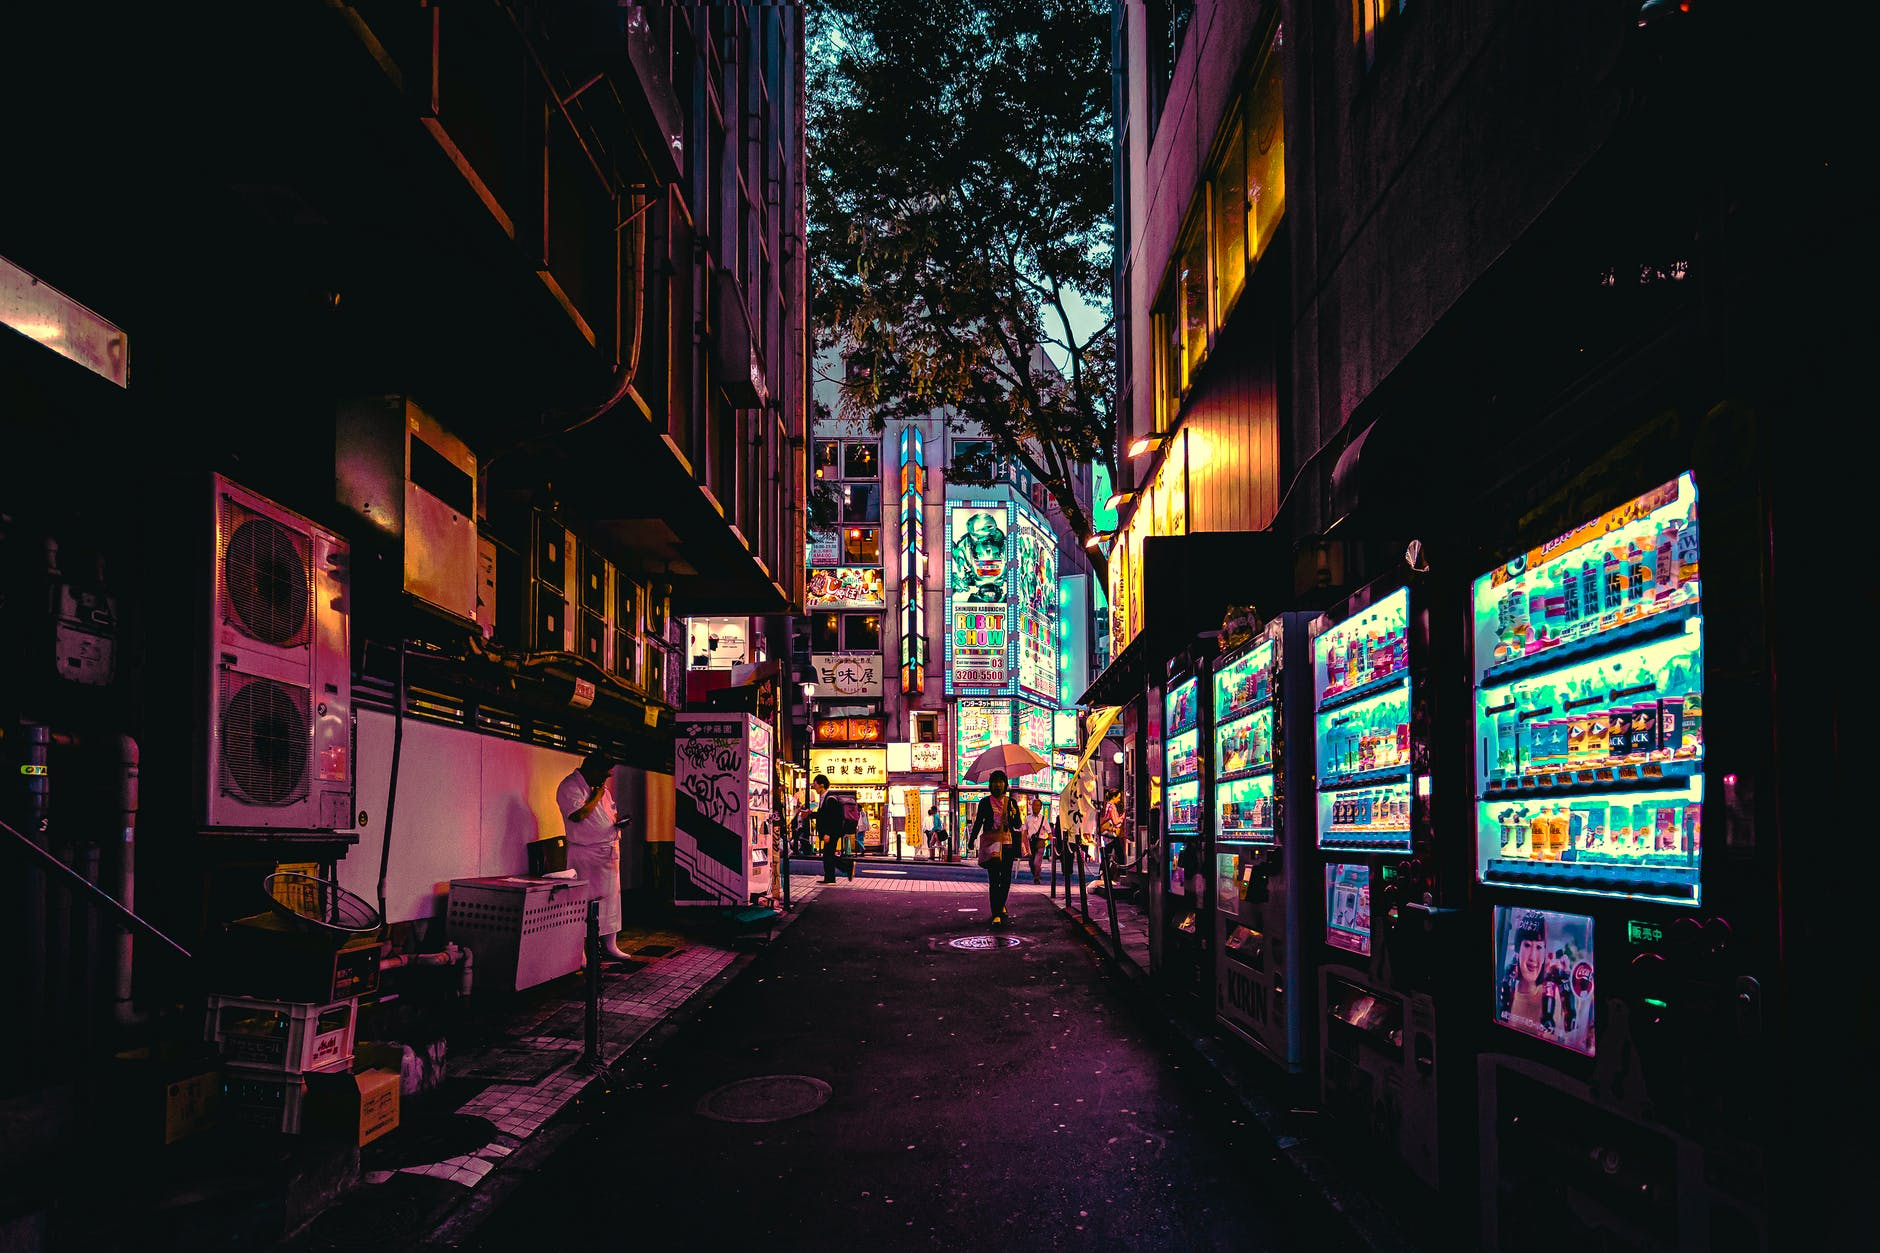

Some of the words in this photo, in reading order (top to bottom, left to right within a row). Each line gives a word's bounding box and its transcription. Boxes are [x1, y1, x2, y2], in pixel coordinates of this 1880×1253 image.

[956, 614, 1003, 630] ROBOT
[956, 629, 1003, 646] SHOW
[910, 658, 916, 670] 2
[991, 659, 1003, 668] 03
[821, 667, 878, 685] 旨味屋
[956, 670, 1003, 680] 3200-5500
[812, 765, 877, 775] 三田製麺所
[1632, 925, 1663, 942] 販売中
[1228, 968, 1268, 1027] KIRIN
[318, 1036, 337, 1051] Asahi
